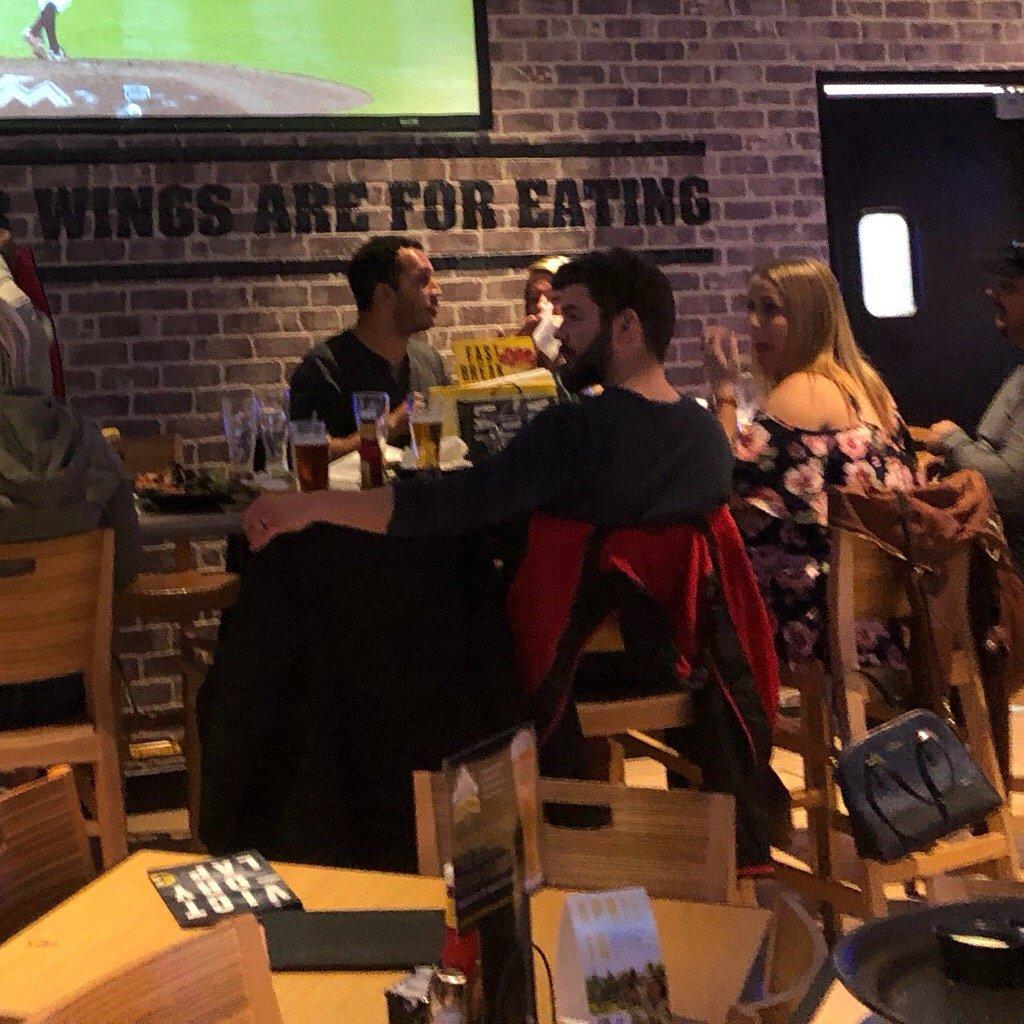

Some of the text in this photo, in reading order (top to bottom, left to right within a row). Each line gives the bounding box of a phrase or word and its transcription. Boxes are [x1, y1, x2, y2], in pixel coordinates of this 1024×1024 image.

[33, 183, 233, 240] WINGS
[255, 181, 371, 235] ARE
[388, 179, 498, 231] FOR
[517, 177, 711, 230] EATING
